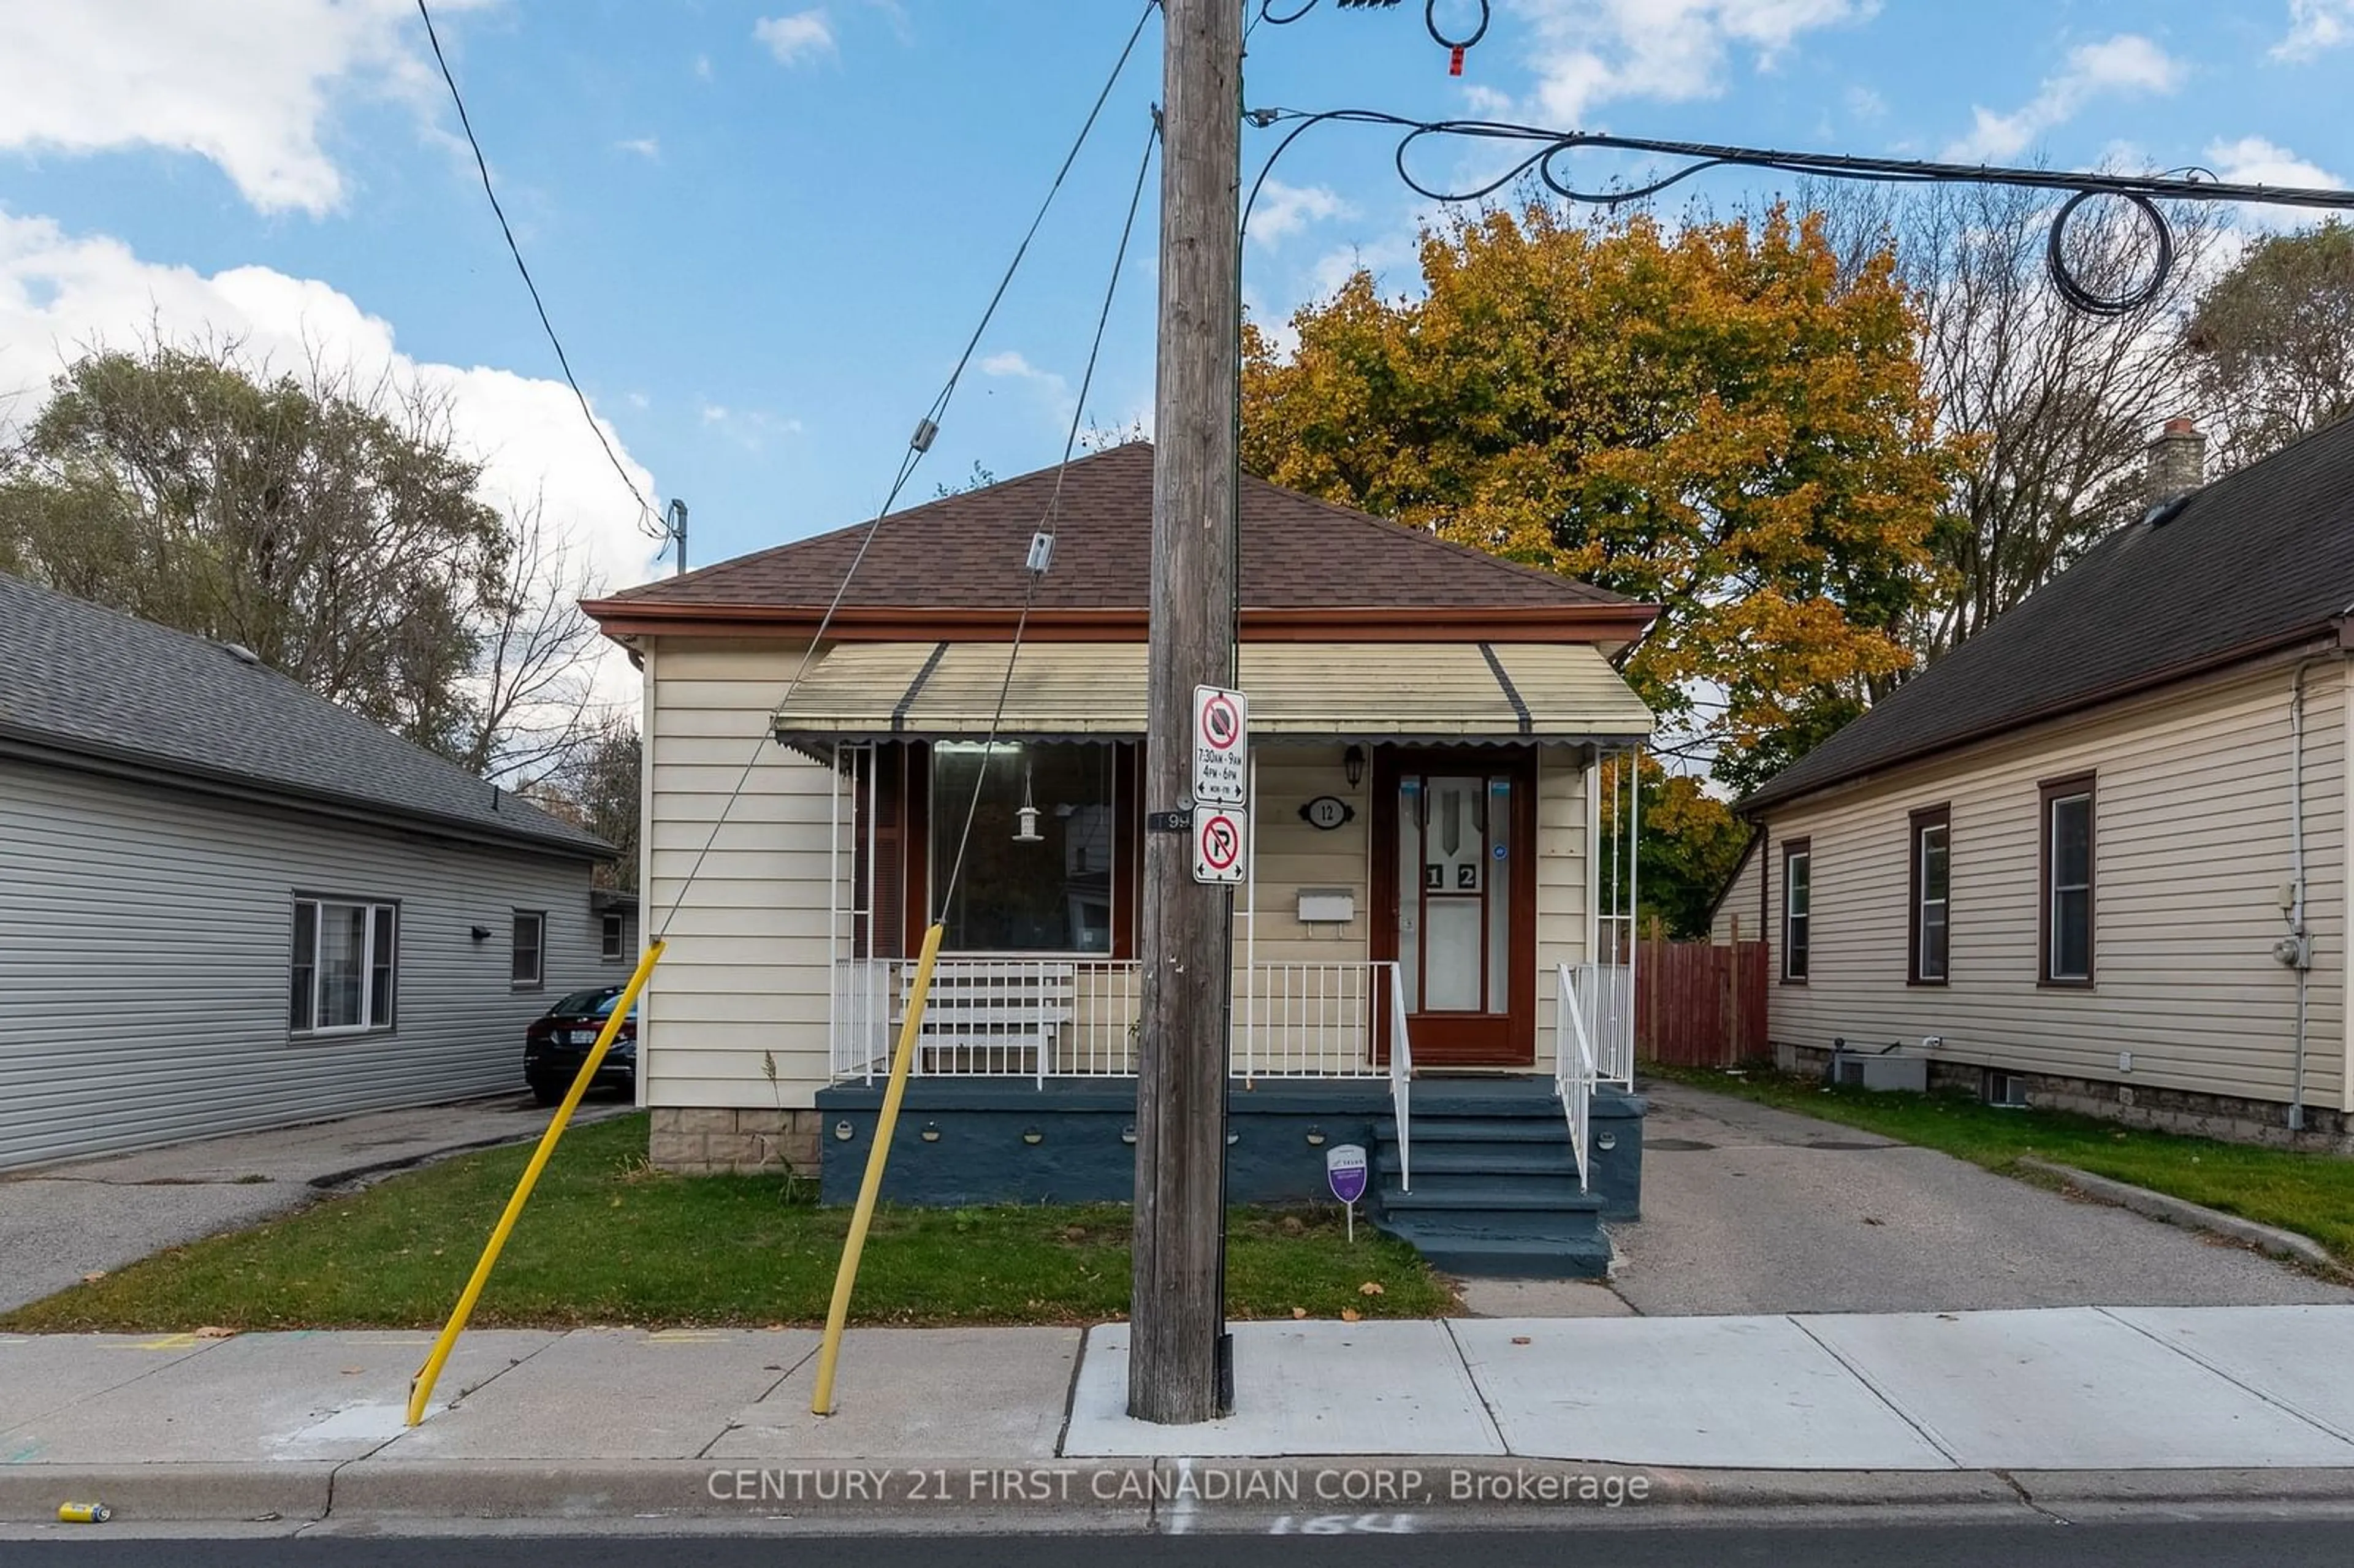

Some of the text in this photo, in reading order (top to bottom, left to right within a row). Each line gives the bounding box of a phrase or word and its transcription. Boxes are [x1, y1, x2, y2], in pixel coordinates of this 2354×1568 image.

[1228, 752, 1241, 765] 9AM
[1203, 764, 1217, 778] 4PM
[1322, 805, 1333, 821] 12
